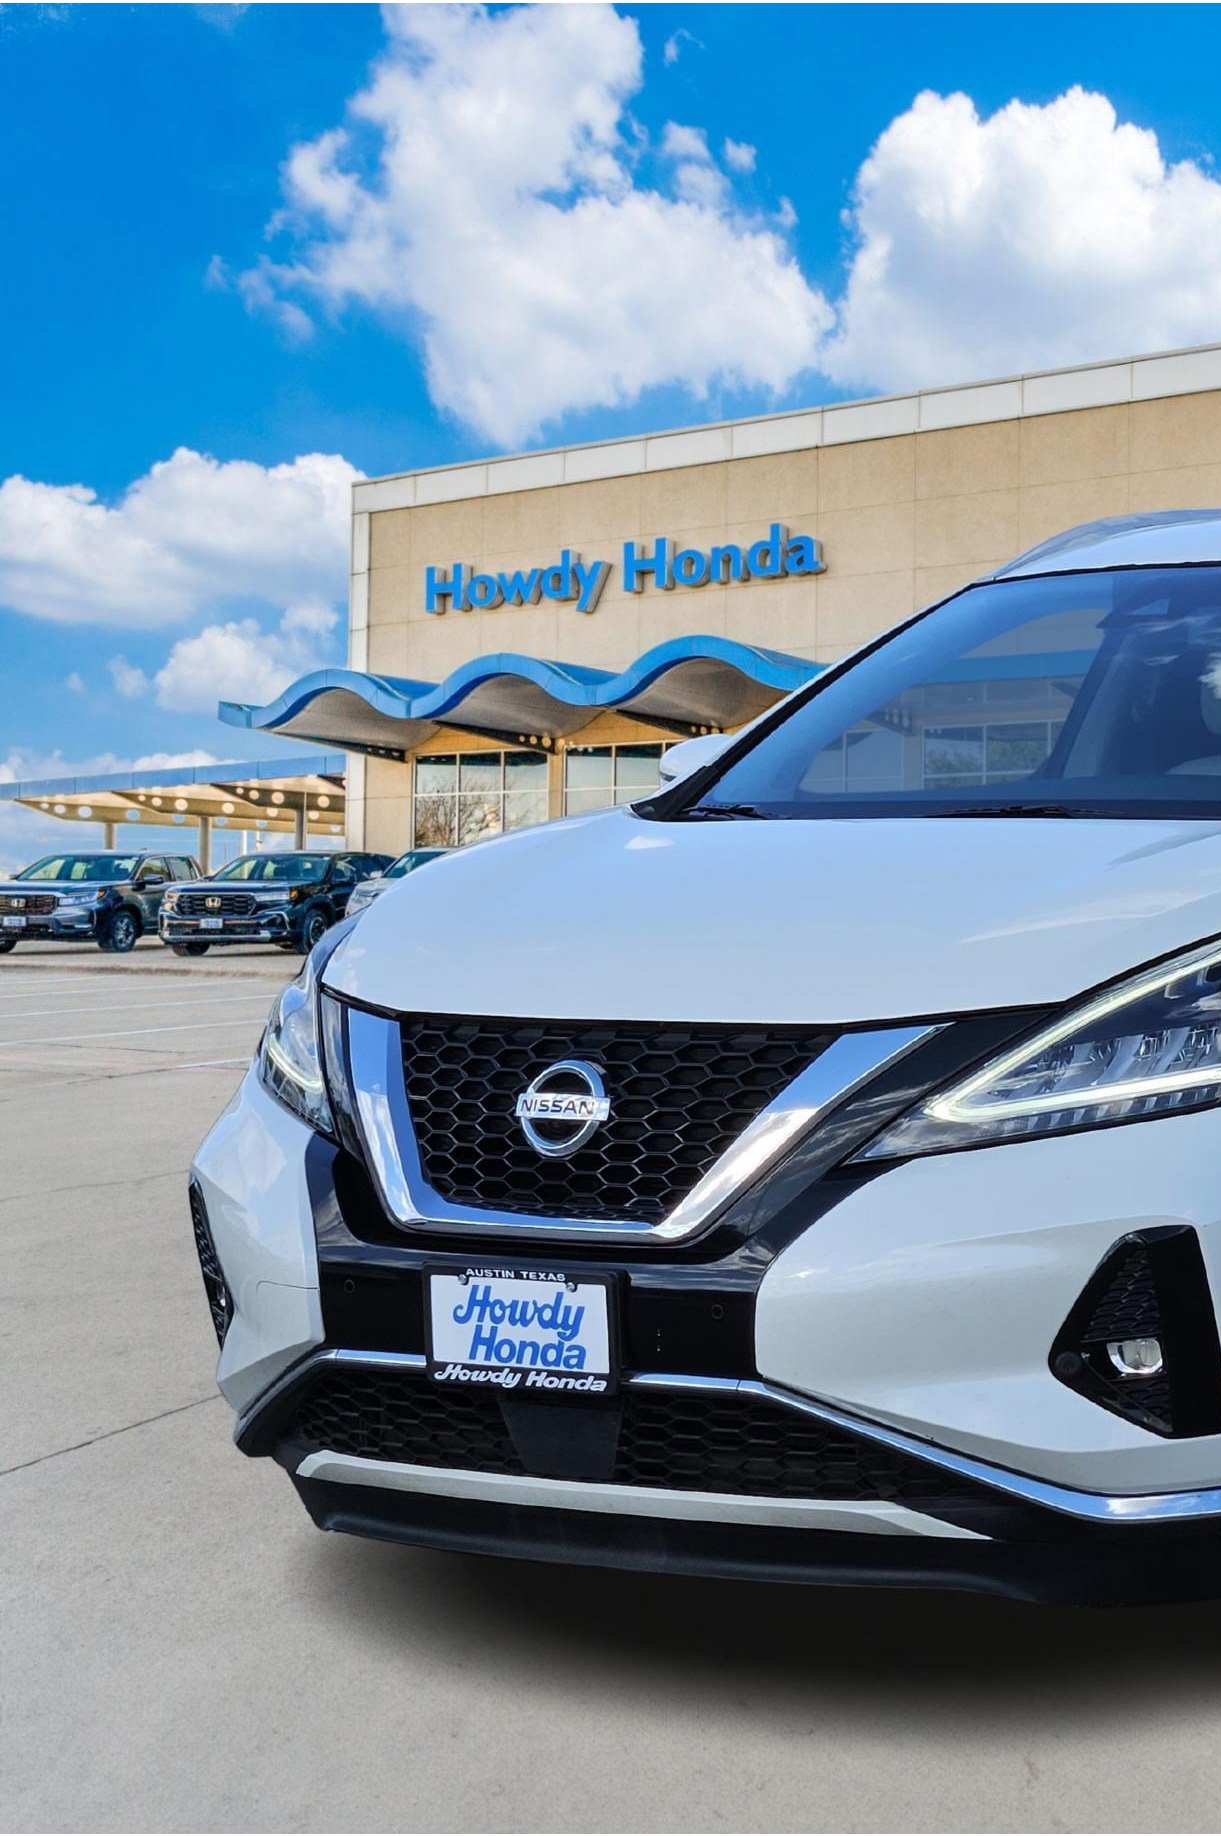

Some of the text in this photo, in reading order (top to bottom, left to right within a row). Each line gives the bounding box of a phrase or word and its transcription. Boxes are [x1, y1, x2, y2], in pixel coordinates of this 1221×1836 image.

[425, 523, 827, 614] Howdy Honda
[520, 1099, 595, 1115] NISSAN
[466, 1268, 566, 1282] AUSTIN TEXAS
[453, 1284, 585, 1342] Howdy
[468, 1324, 587, 1370] Honda
[434, 1364, 607, 1392] Howdy Honda
